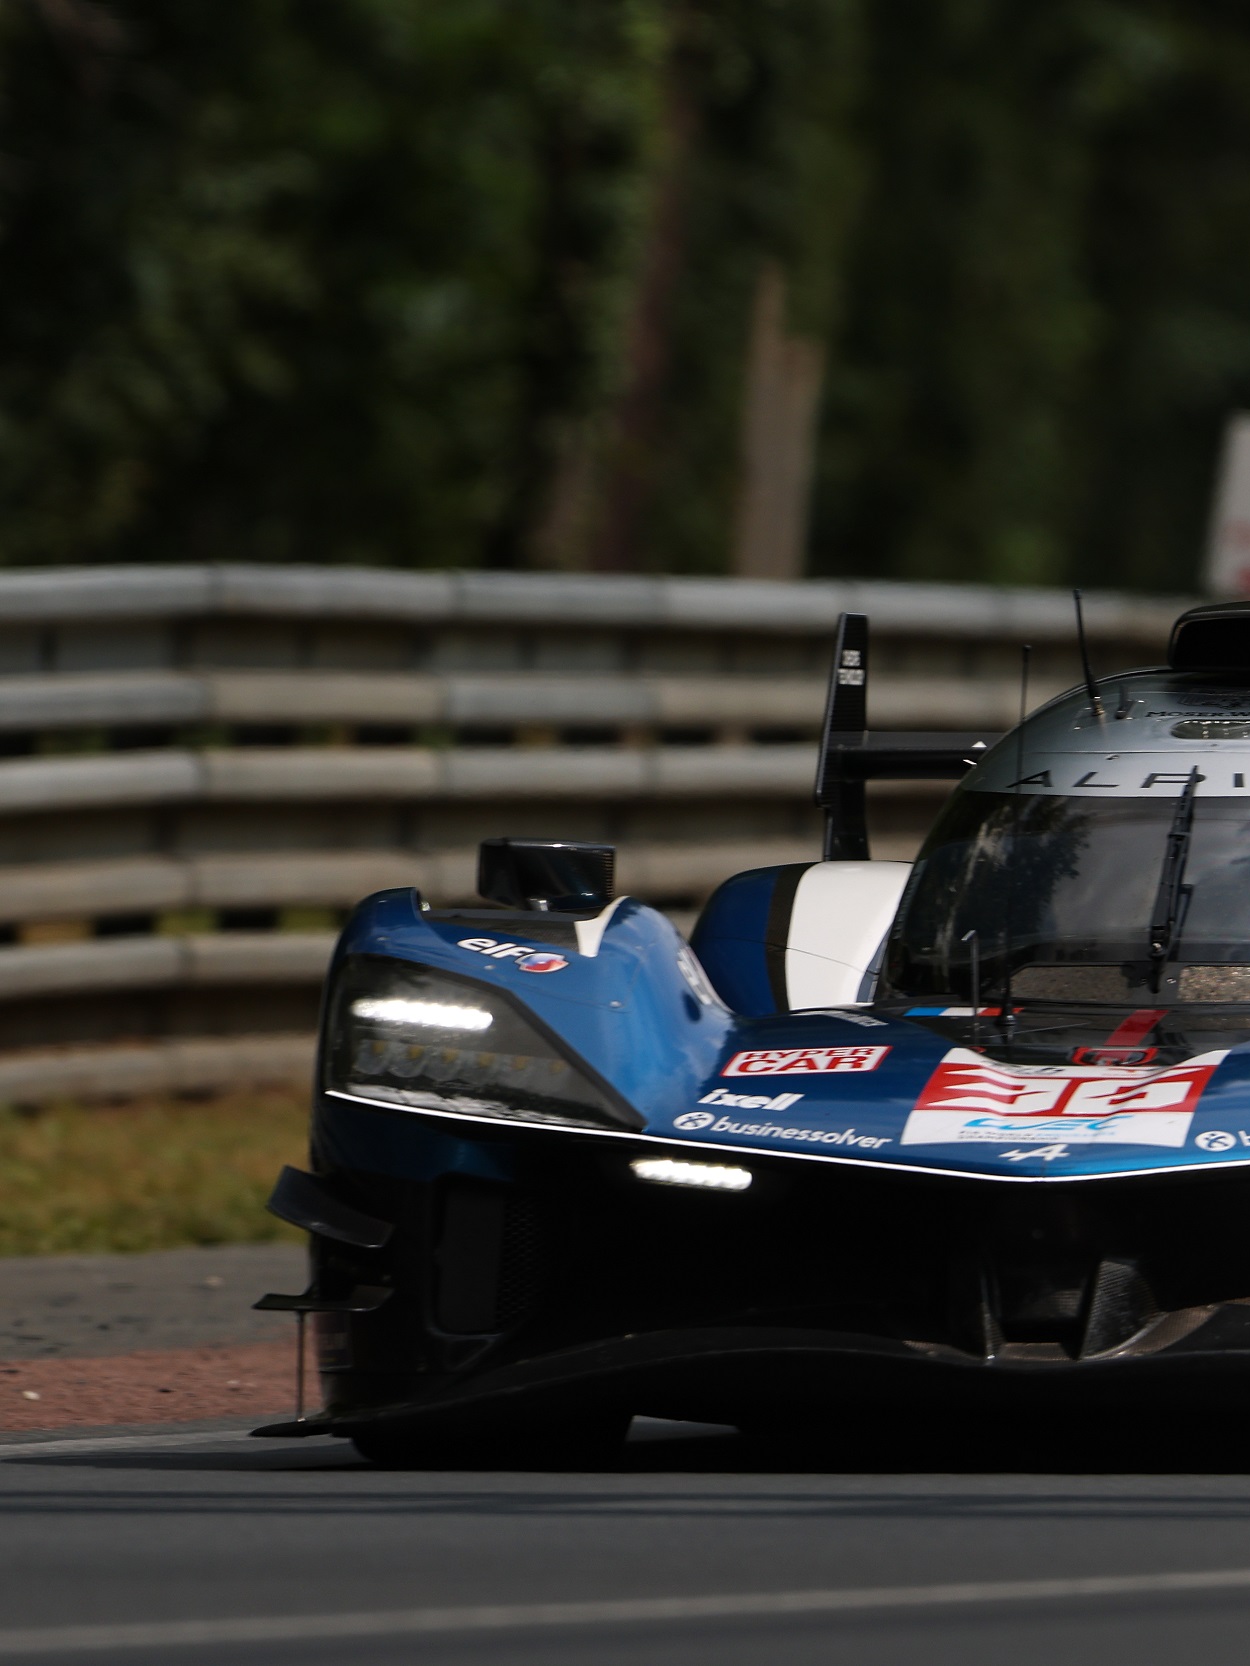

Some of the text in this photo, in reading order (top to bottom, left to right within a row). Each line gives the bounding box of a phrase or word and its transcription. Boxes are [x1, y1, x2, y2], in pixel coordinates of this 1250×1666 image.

[457, 938, 537, 958] elf
[738, 1056, 867, 1073] CAR
[744, 1048, 873, 1060] HYPER
[697, 1088, 805, 1111] ixell
[925, 1067, 1204, 1115] 36
[710, 1115, 893, 1149] businessolver
